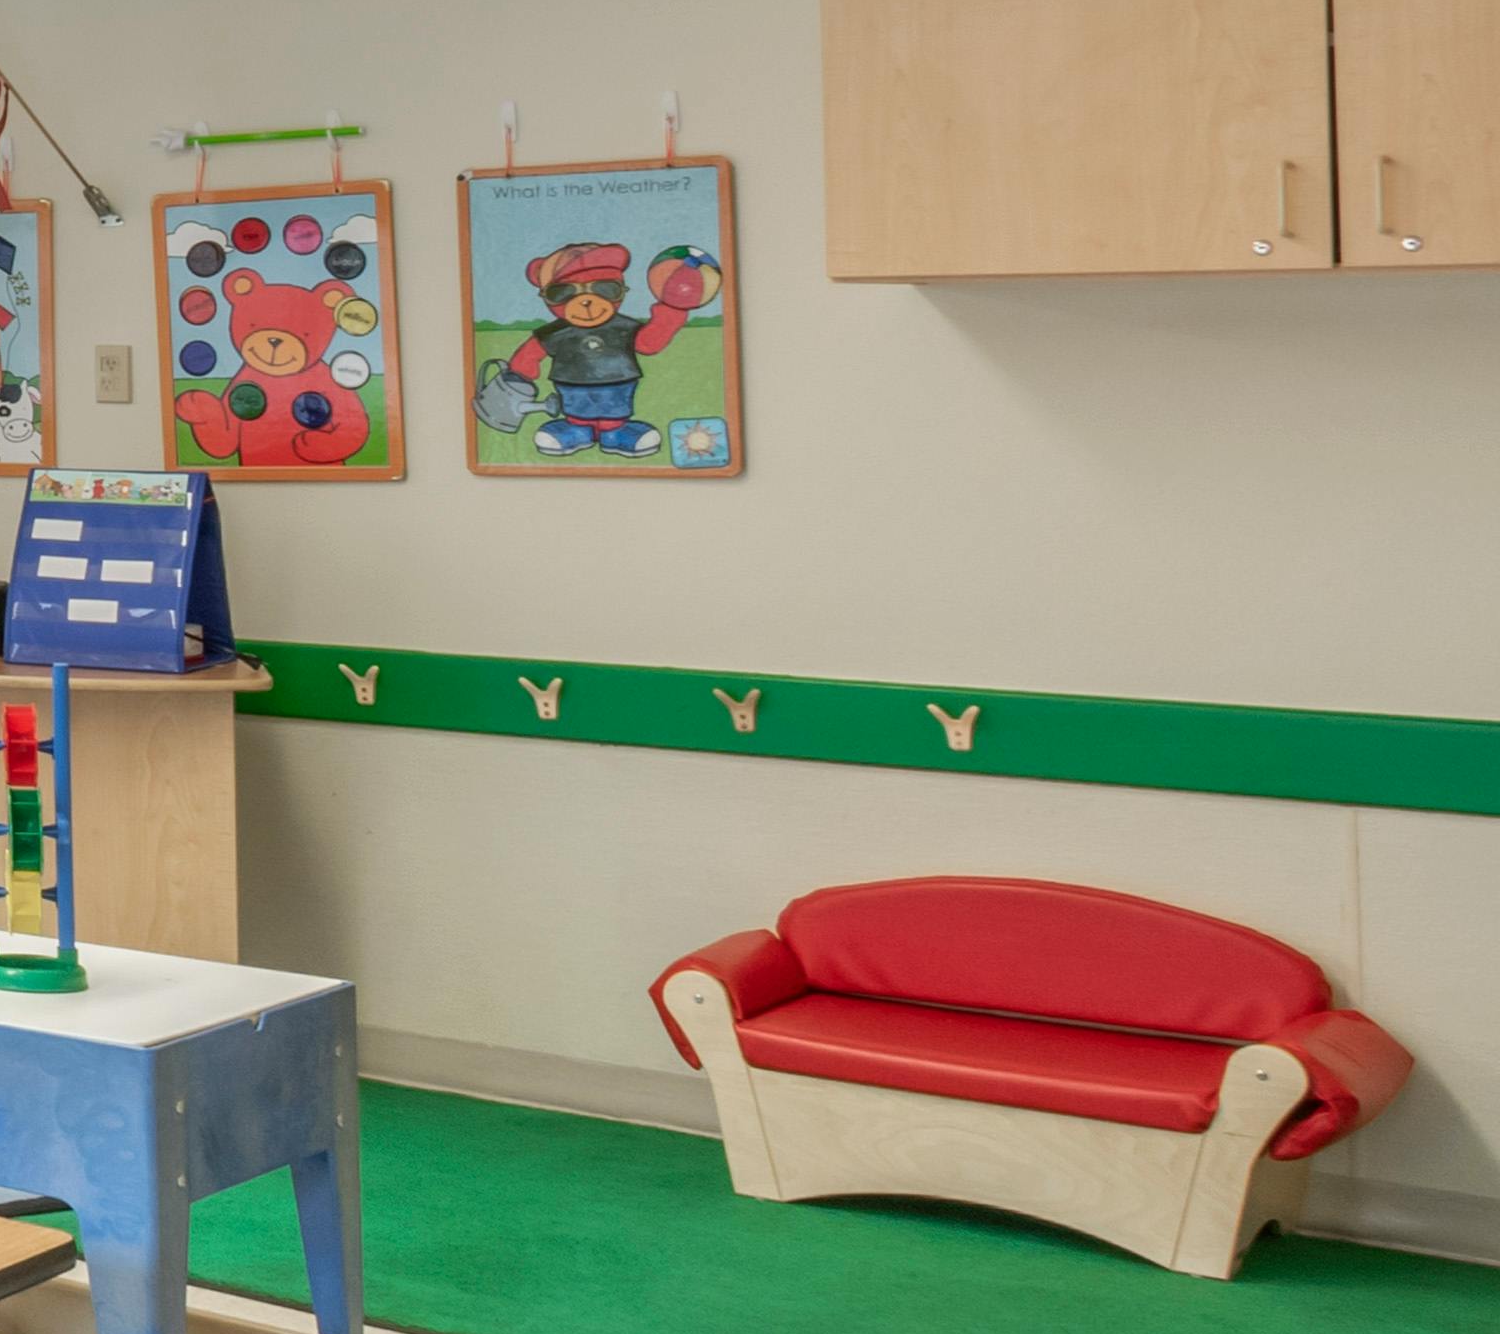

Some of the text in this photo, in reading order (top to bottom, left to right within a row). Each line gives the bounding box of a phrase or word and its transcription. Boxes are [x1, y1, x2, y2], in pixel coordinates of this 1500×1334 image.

[492, 176, 691, 200] What is the Weather?
